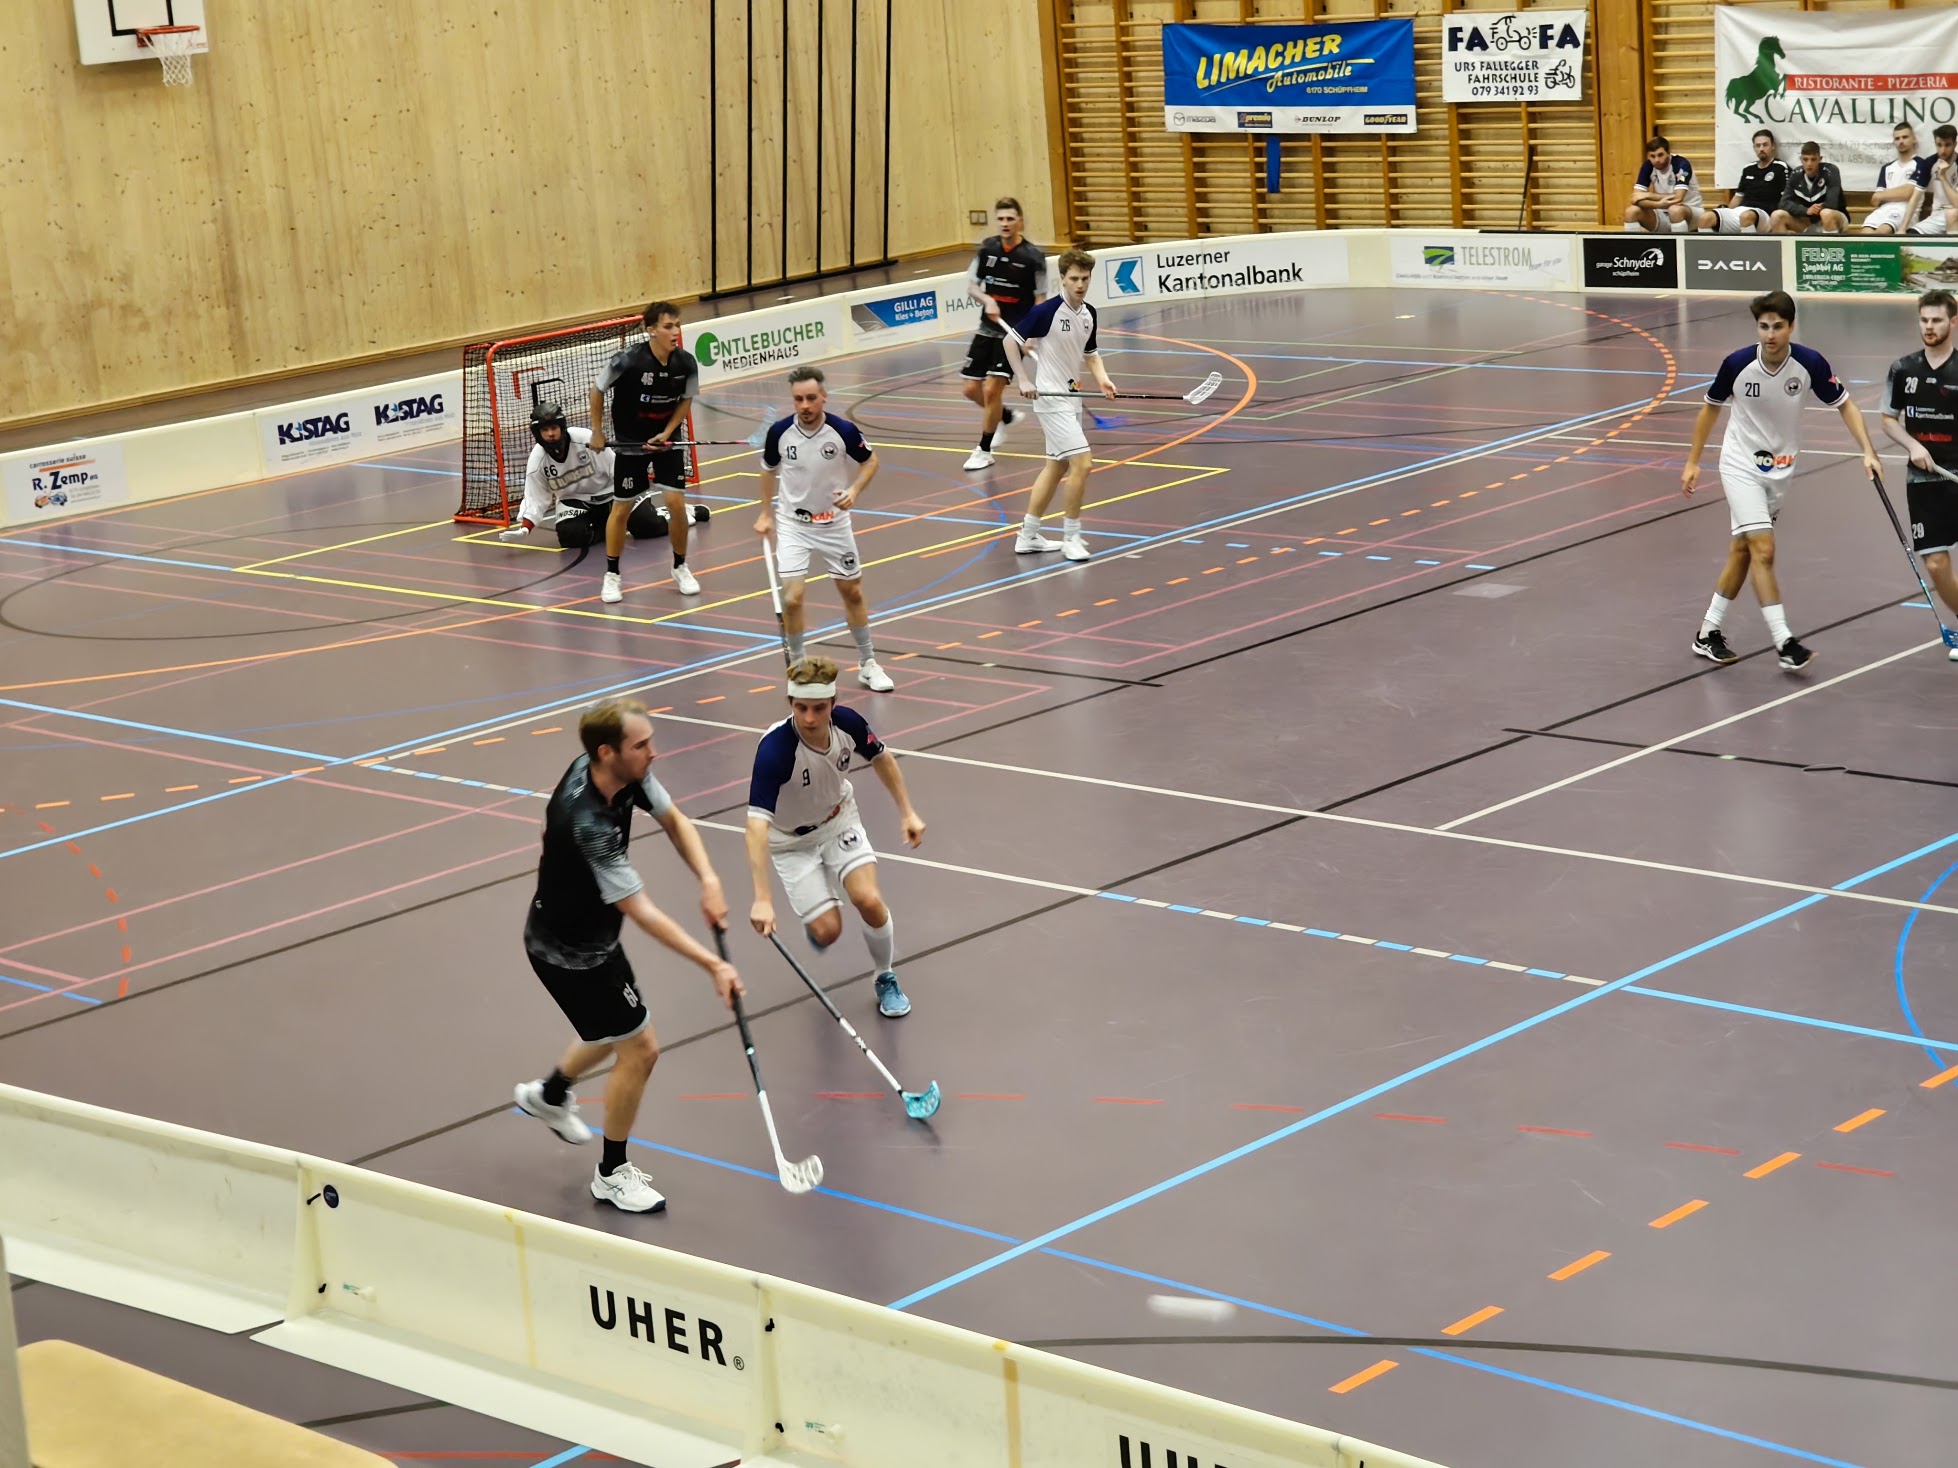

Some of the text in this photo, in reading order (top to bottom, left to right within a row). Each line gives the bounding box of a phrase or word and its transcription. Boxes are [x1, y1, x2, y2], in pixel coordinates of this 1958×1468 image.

[1448, 23, 1581, 52] FA FA
[1196, 34, 1342, 89] LIMACHER
[1454, 60, 1539, 72] URS FALLEGGER
[1267, 61, 1352, 93] Automobile
[1468, 73, 1539, 84] FAHRSCHULE
[1795, 77, 1875, 90] RISTORANTE
[1888, 76, 1948, 90] PIZZERIA
[1306, 86, 1322, 94] 6170
[1472, 85, 1539, 96] 079 341 92 93
[1764, 93, 1956, 125] CAVALLINO
[1157, 250, 1231, 269] Luzerner
[1460, 246, 1532, 267] TELESTROM
[1801, 247, 1846, 262] FELDER
[1613, 256, 1655, 270] Schnyder
[1697, 259, 1767, 271] DACIA
[1832, 263, 1844, 272] AG
[1158, 262, 1304, 294] Kantonalbank
[894, 296, 933, 313] GILLI AG
[895, 312, 909, 321] Kies
[915, 308, 934, 318] Beton
[1060, 319, 1071, 332] 26
[709, 321, 825, 361] ENTLEBUCHER
[722, 345, 799, 372] MEDIENHAUS
[1745, 382, 1760, 398] 20
[1905, 377, 1919, 394] 29
[786, 445, 797, 460] 13
[32, 477, 48, 491] R.
[49, 470, 88, 491] Zemp
[622, 477, 634, 489] 46
[1912, 523, 1925, 539] 29
[802, 768, 811, 787] 9
[589, 1284, 727, 1367] UHER
